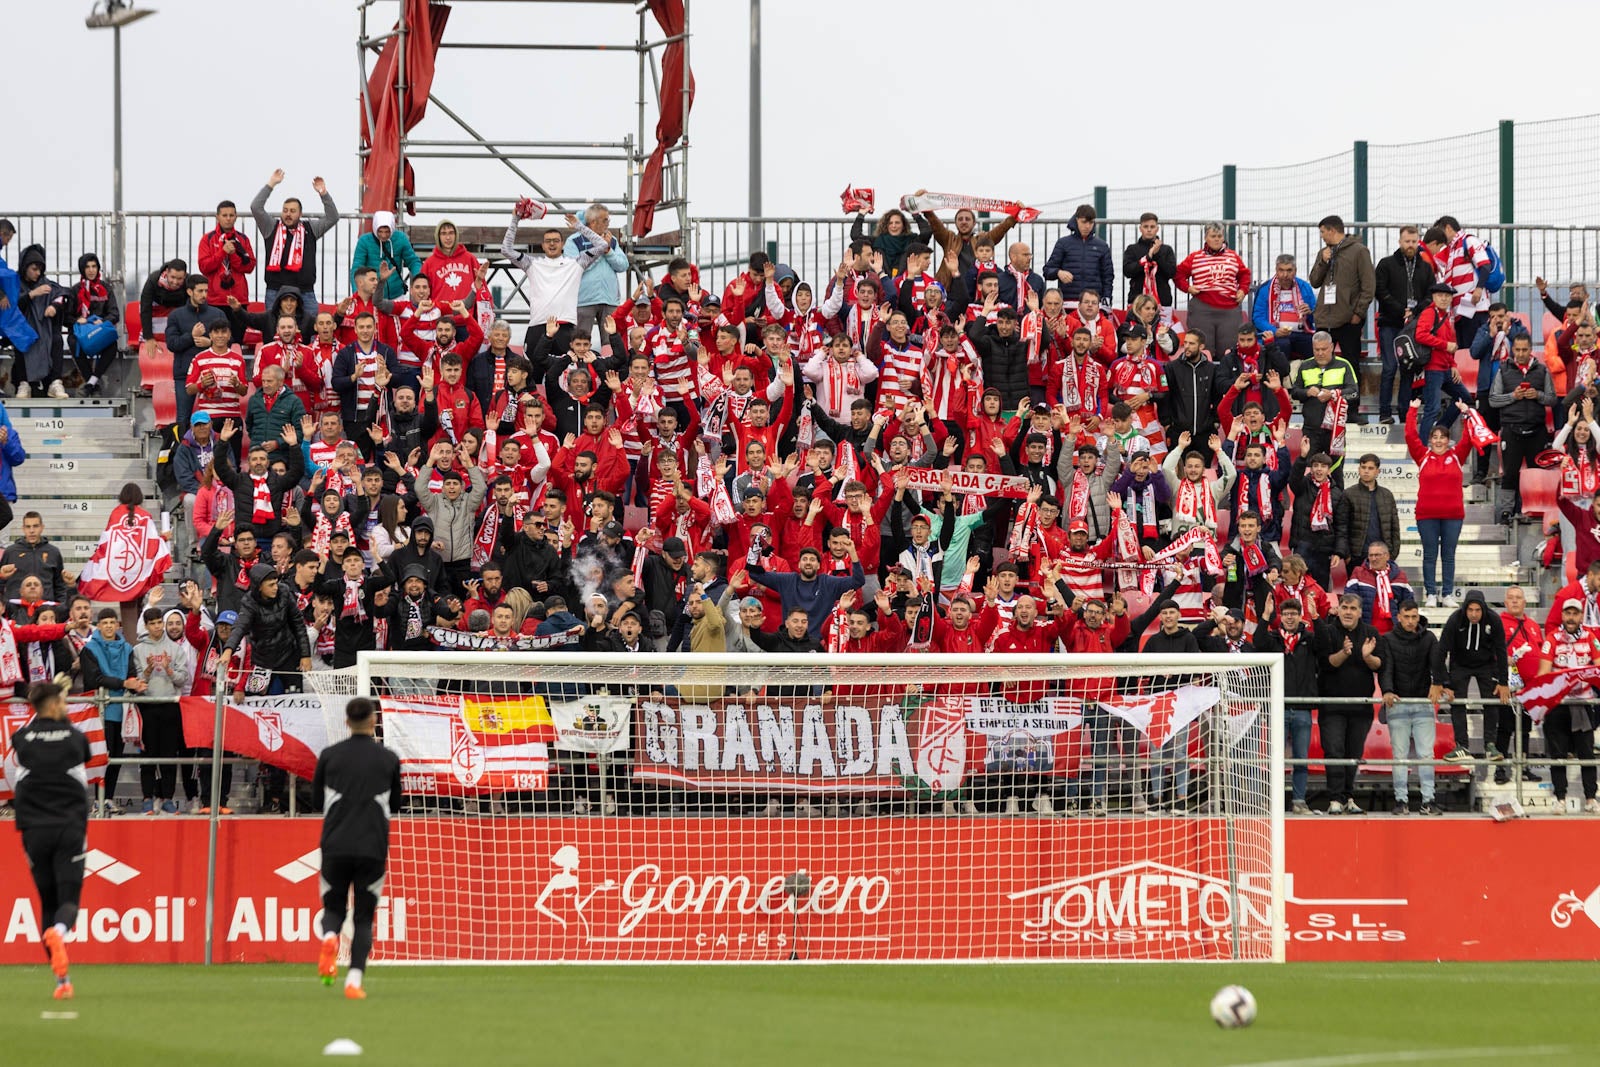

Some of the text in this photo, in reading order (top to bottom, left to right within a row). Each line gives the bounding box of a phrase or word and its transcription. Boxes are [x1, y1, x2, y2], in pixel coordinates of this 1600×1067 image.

[436, 262, 470, 279] CANADA
[51, 420, 64, 429] 10
[1375, 426, 1387, 435] 10
[67, 461, 75, 470] 9
[1395, 466, 1403, 475] 9
[81, 502, 88, 511] 8
[1455, 588, 1462, 598] 6
[433, 628, 495, 650] CURVA
[980, 699, 995, 713] DE
[966, 719, 977, 728] TE
[1023, 719, 1029, 728] A
[1032, 719, 1069, 730] SEGUIR
[642, 700, 915, 777] GRANADA
[400, 773, 543, 791] INCE 1931
[4, 896, 185, 943] Aucoil
[695, 930, 787, 947] CAFÉS
